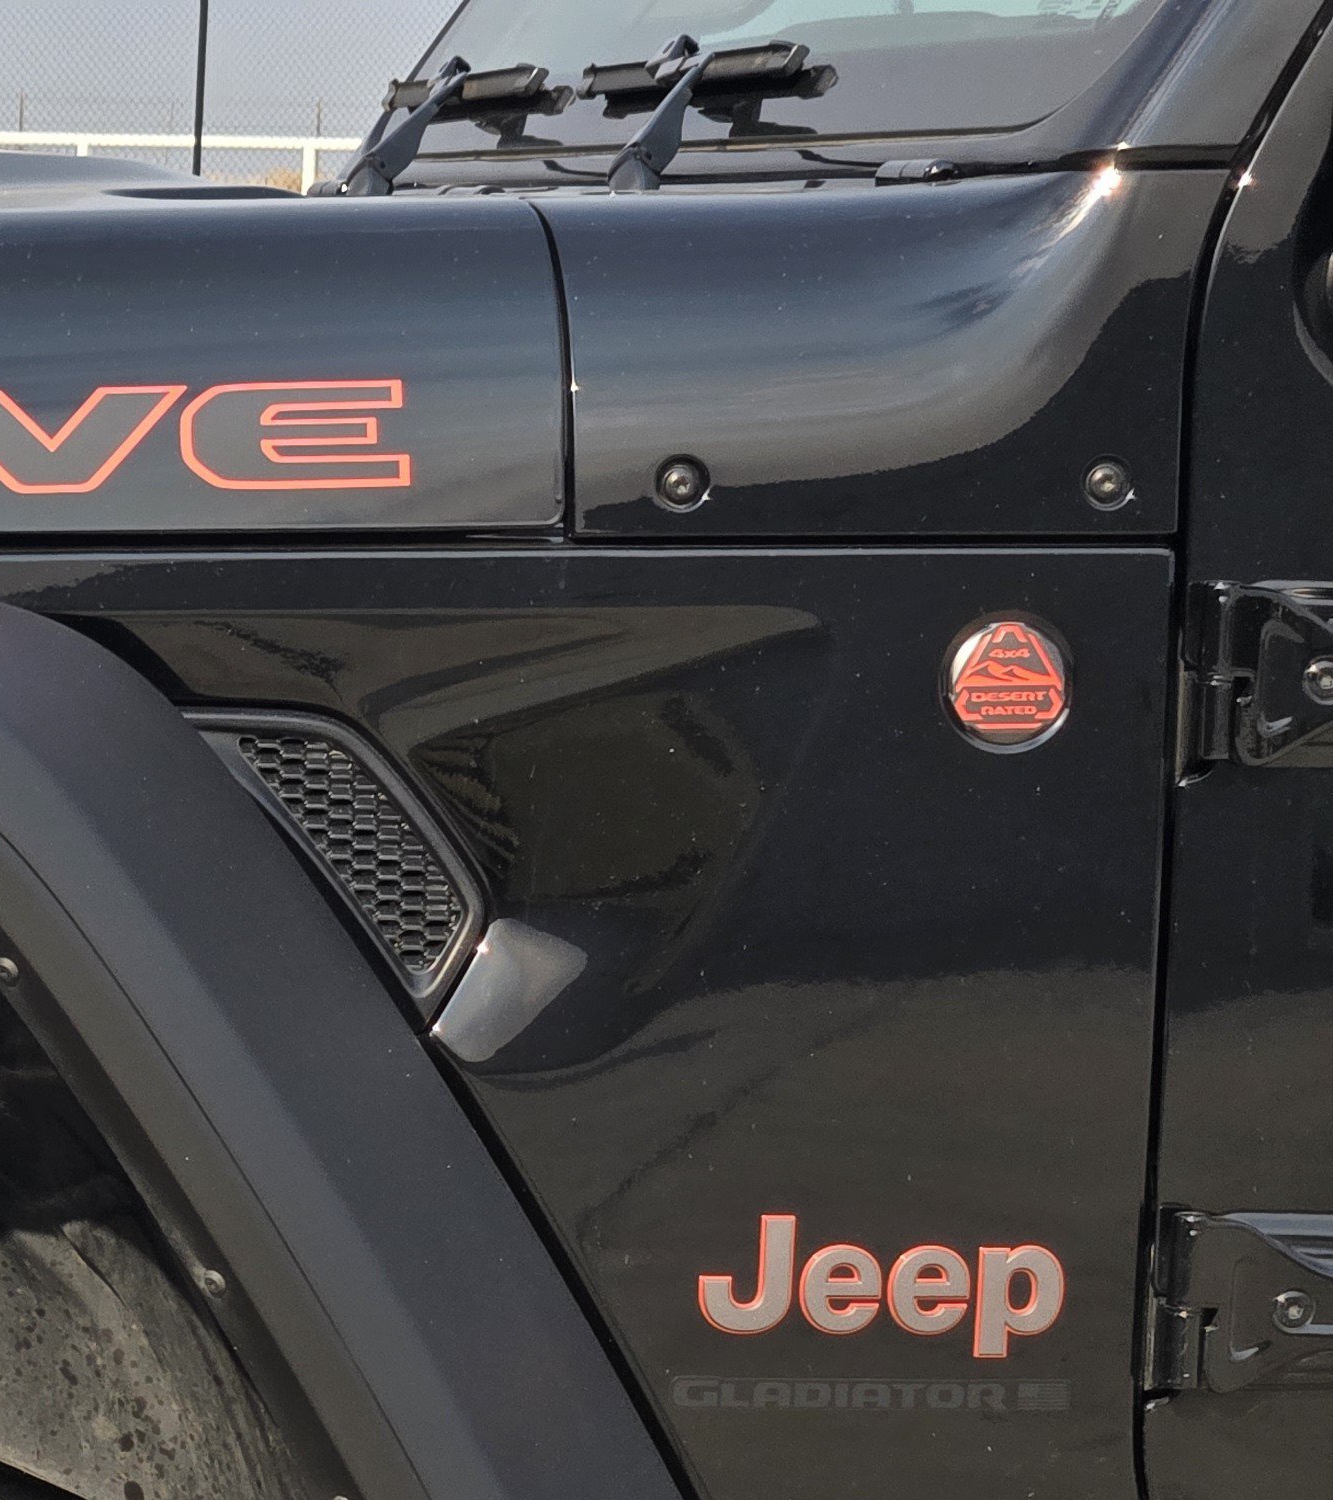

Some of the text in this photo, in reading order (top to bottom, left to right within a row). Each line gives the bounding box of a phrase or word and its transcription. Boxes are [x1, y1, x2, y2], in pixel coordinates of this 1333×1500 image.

[988, 647, 1031, 659] 4x4
[970, 690, 1048, 703] DESERT
[980, 704, 1038, 717] RATED
[697, 1213, 1066, 1359] Jeep
[670, 1375, 1007, 1413] GLADIATOR
